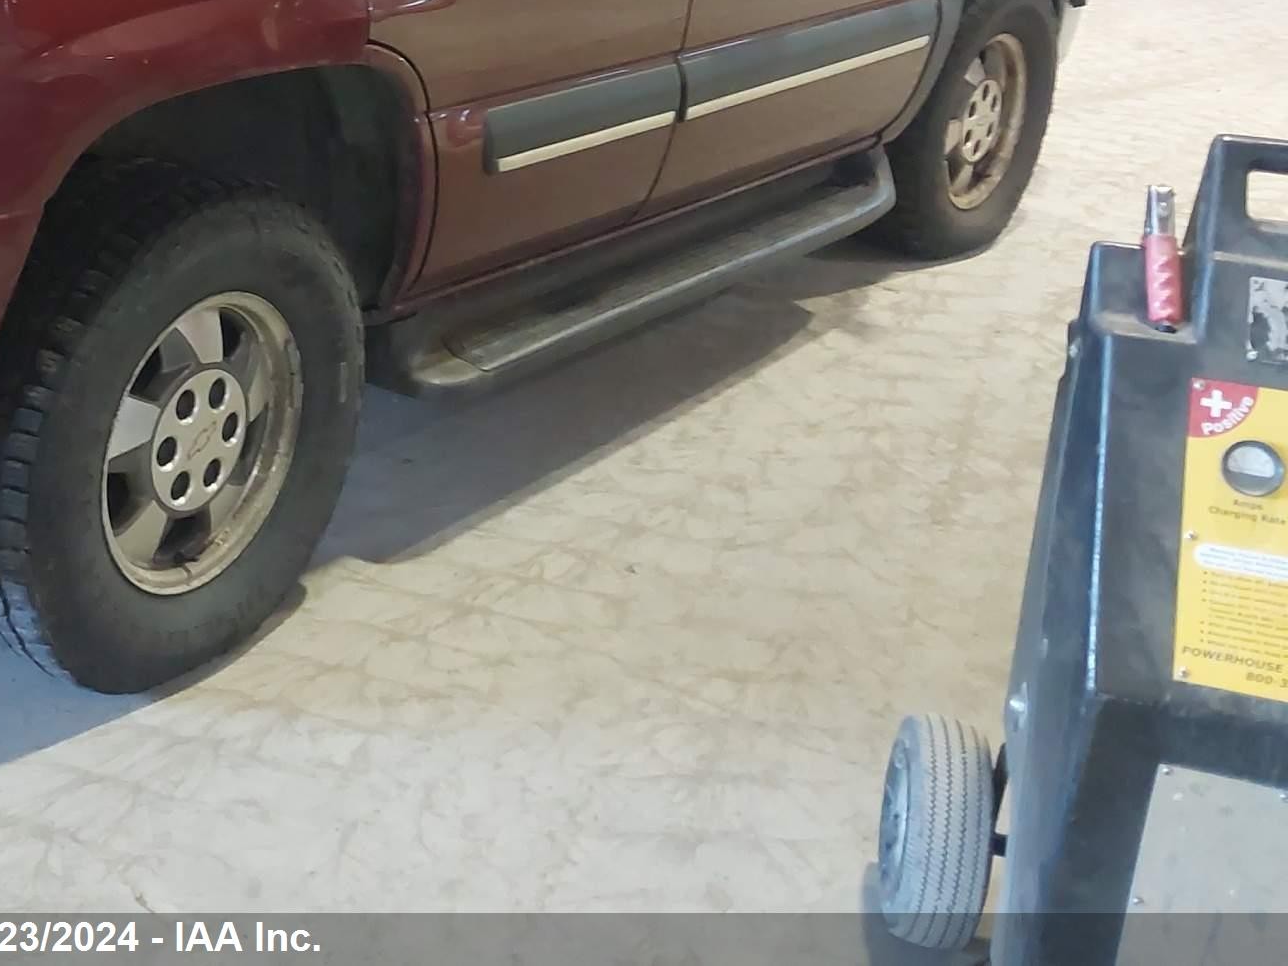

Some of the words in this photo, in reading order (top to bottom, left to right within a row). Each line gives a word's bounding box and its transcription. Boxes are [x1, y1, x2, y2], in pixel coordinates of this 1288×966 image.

[1201, 396, 1254, 435] Positive
[1208, 505, 1257, 522] Charging
[1181, 646, 1284, 674] POWERHOUSE
